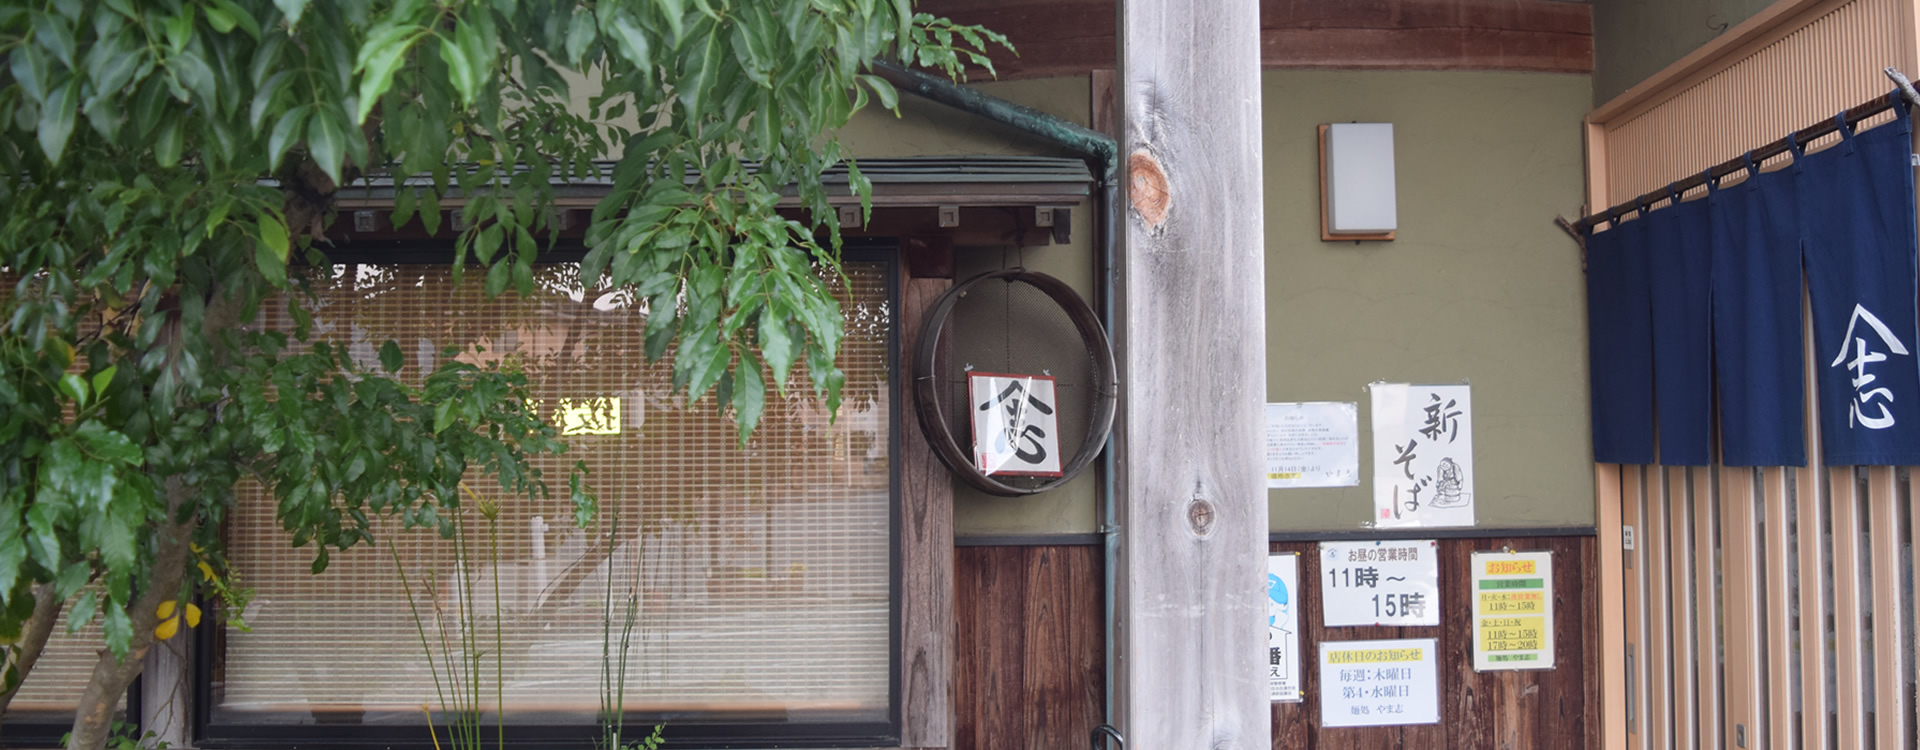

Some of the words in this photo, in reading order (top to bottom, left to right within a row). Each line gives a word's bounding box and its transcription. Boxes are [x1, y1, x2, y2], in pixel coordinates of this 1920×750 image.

[1348, 547, 1418, 562] お昼の営業時間
[1488, 561, 1533, 574] お知らせ
[1372, 592, 1426, 618] 15時
[1329, 649, 1421, 663] 店休日のお知らせ
